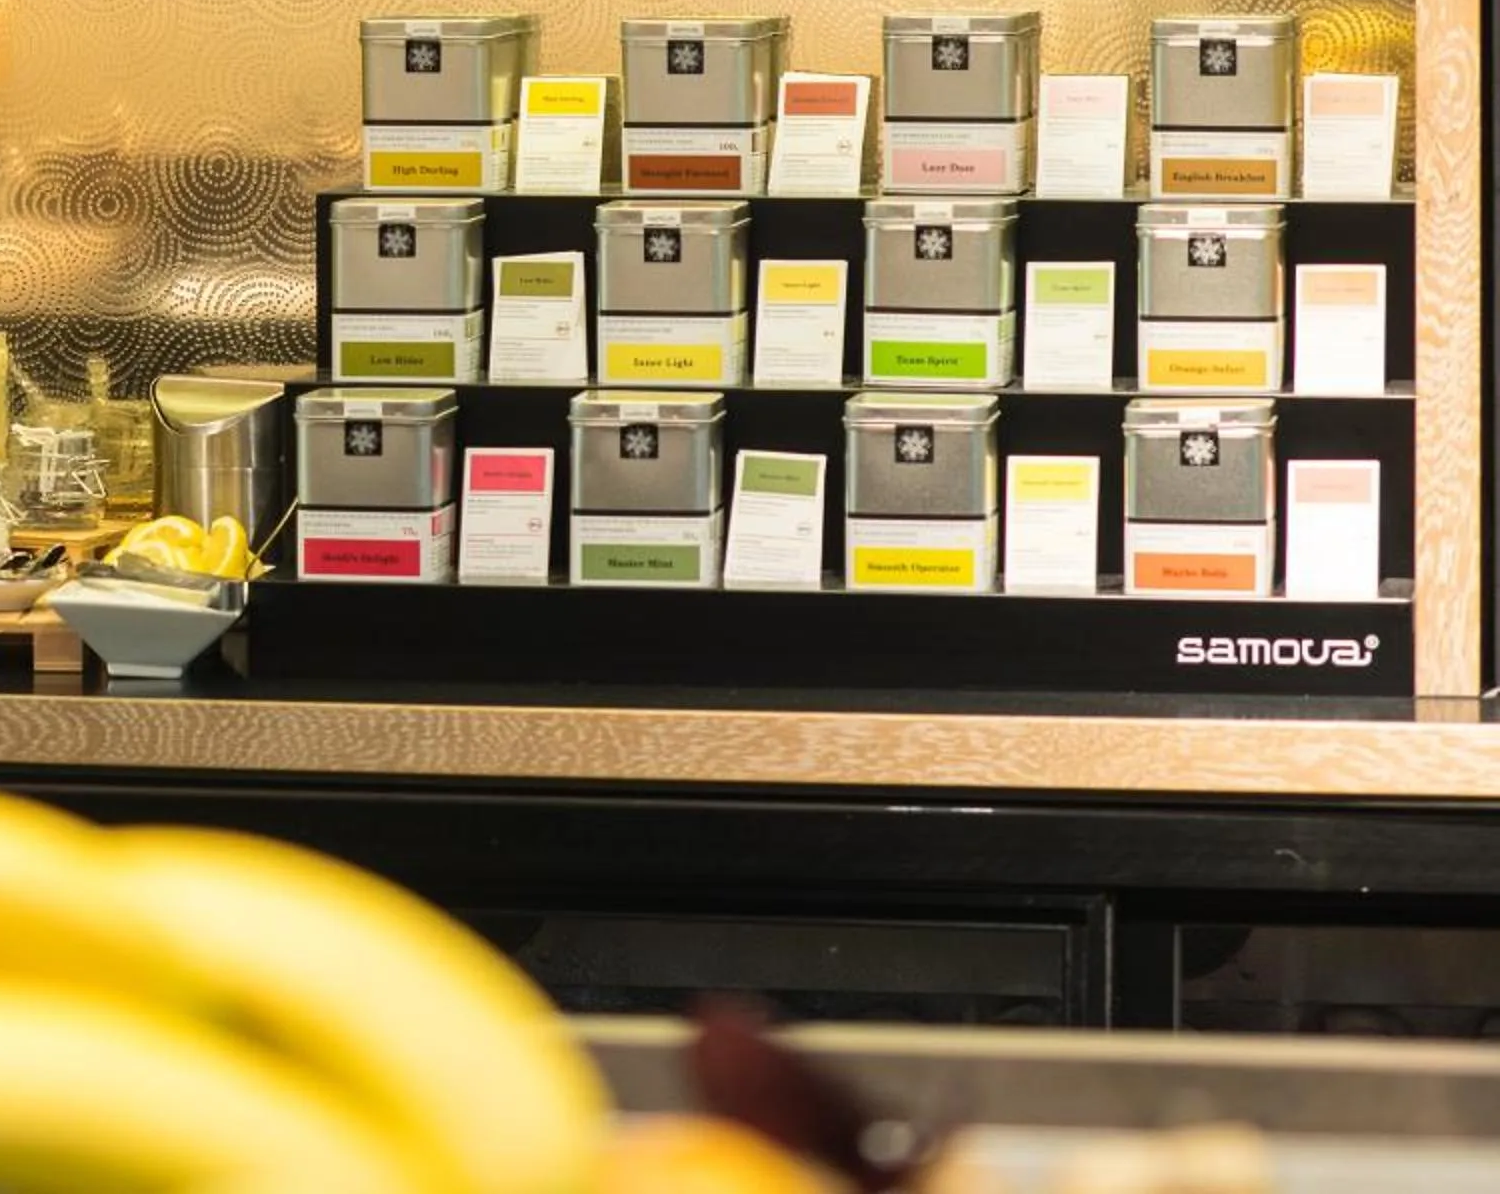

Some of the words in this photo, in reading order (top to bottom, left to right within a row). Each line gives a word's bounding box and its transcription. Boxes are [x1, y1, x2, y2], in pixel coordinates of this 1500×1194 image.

[392, 165, 417, 176] High
[1172, 172, 1212, 183] English
[1215, 172, 1266, 182] Breakfast
